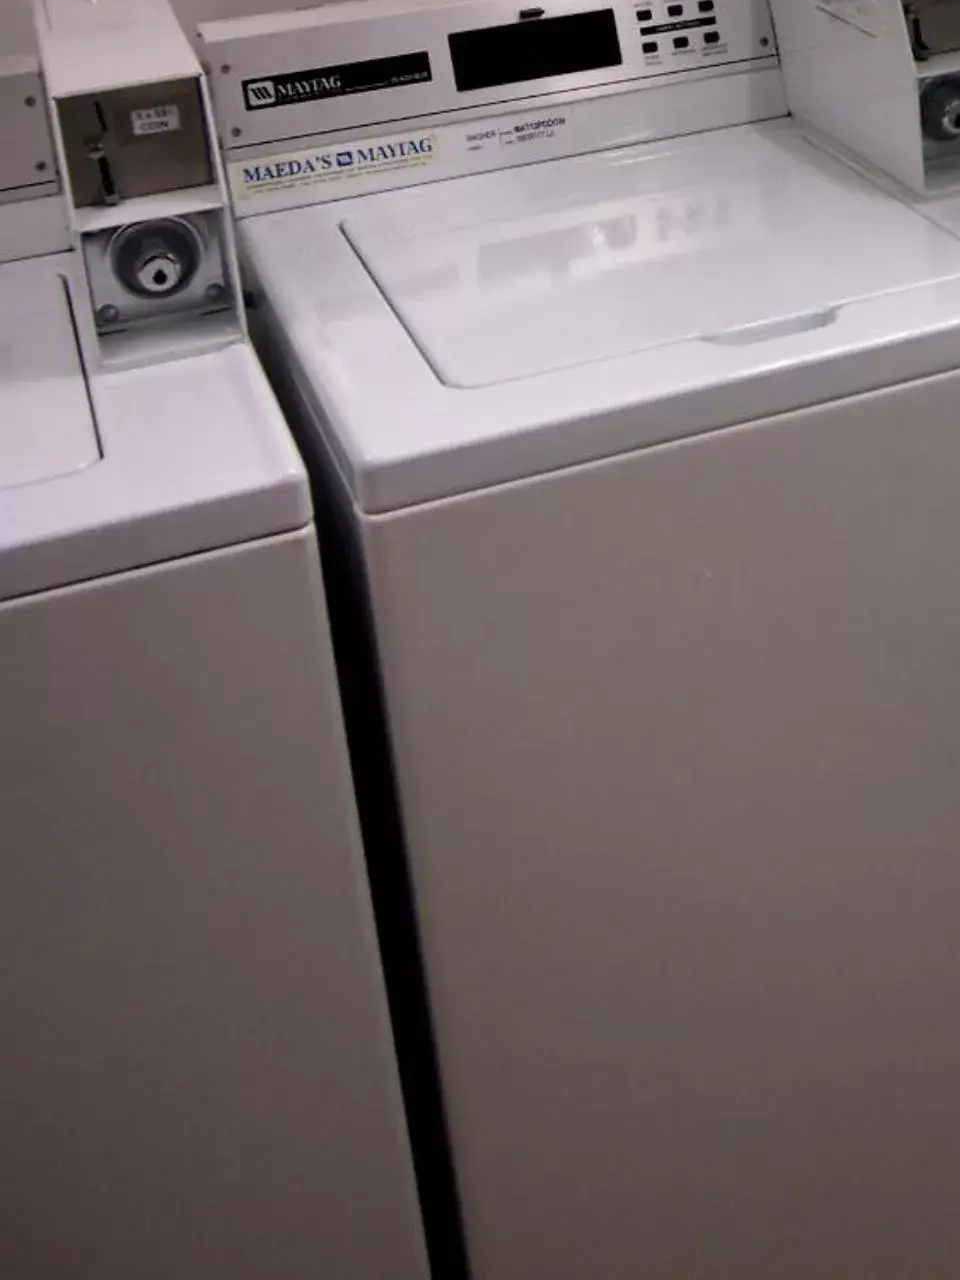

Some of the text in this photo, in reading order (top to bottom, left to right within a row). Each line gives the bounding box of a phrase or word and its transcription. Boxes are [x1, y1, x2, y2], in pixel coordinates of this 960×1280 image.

[276, 74, 342, 100] MAYTAG
[242, 138, 434, 183] MAEDA'S MAYTAG
